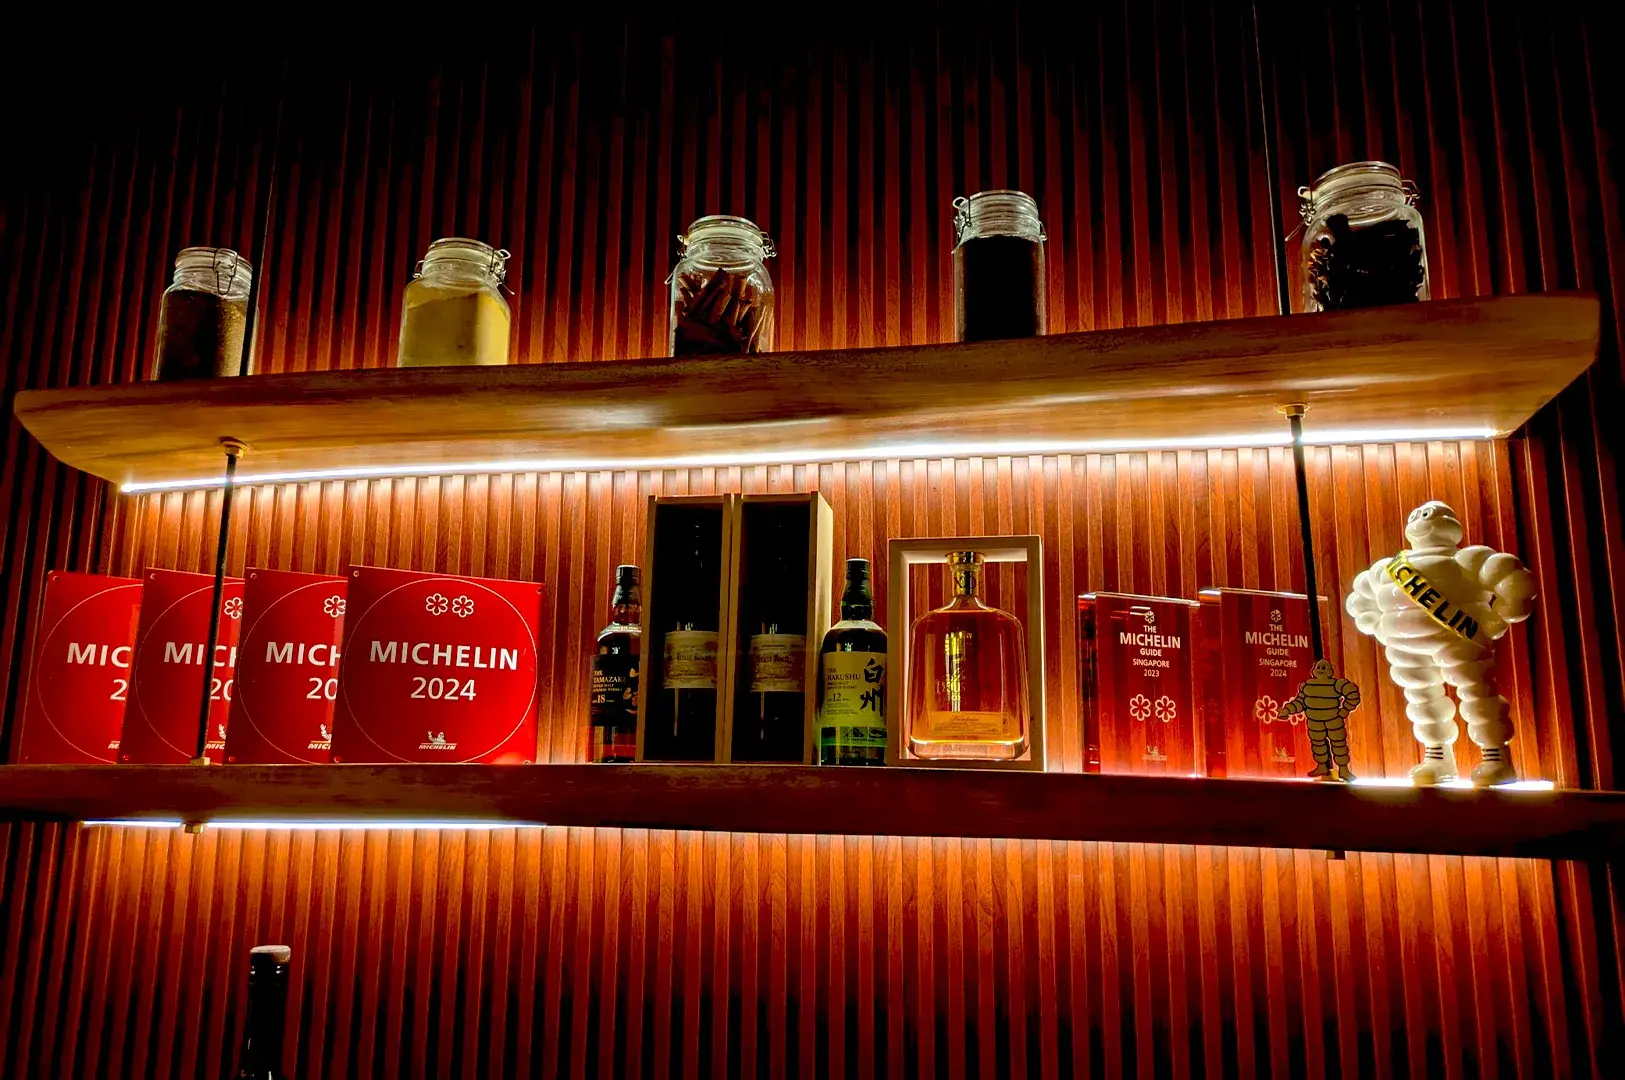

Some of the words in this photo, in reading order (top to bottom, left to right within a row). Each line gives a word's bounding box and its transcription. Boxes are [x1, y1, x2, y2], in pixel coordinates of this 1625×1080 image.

[1143, 624, 1157, 633] THE
[1269, 623, 1284, 632] THE
[1119, 632, 1181, 649] MICHELIN
[1245, 631, 1309, 648] MICHELIN
[369, 640, 519, 670] MICHELIN
[1139, 648, 1162, 657] GUIDE
[1266, 647, 1289, 656] GUIDE
[1132, 658, 1170, 668] SINGAPORE
[1258, 658, 1298, 668] SINGAPORE
[827, 673, 860, 681] HAKUSHU
[1143, 669, 1160, 678] 2023
[1270, 669, 1288, 678] 2024
[410, 676, 477, 701] 2024
[860, 657, 884, 717] 白州
[833, 692, 842, 702] 12
